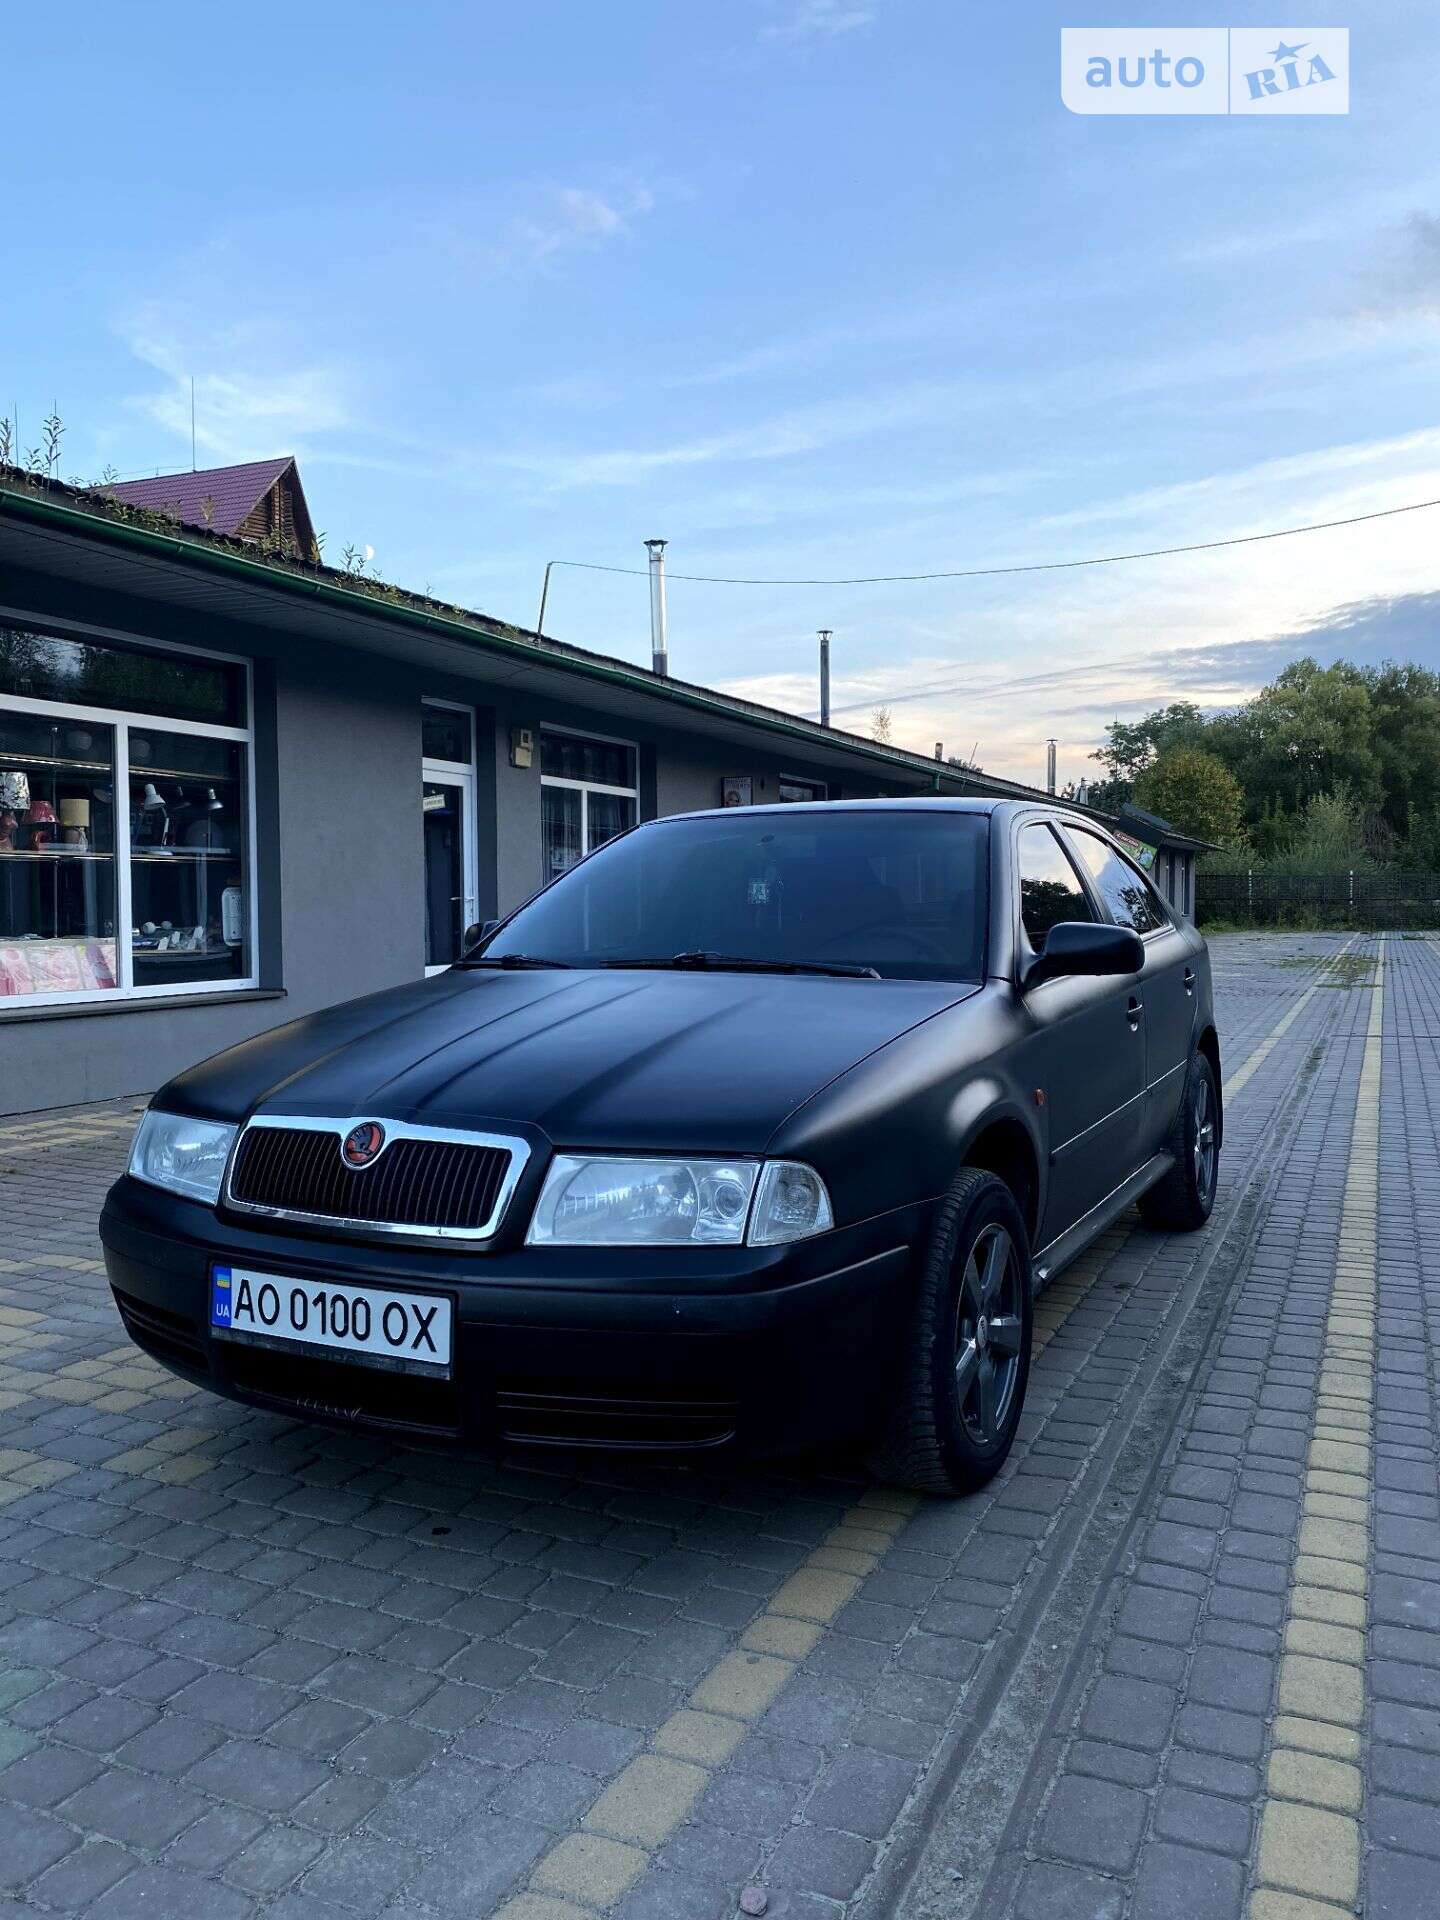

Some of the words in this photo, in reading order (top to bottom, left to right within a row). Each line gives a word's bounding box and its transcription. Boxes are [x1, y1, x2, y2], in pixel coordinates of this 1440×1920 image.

[216, 1303, 230, 1318] UA
[234, 1279, 280, 1326] AO
[290, 1288, 371, 1342] 0100
[382, 1301, 438, 1353] OX
